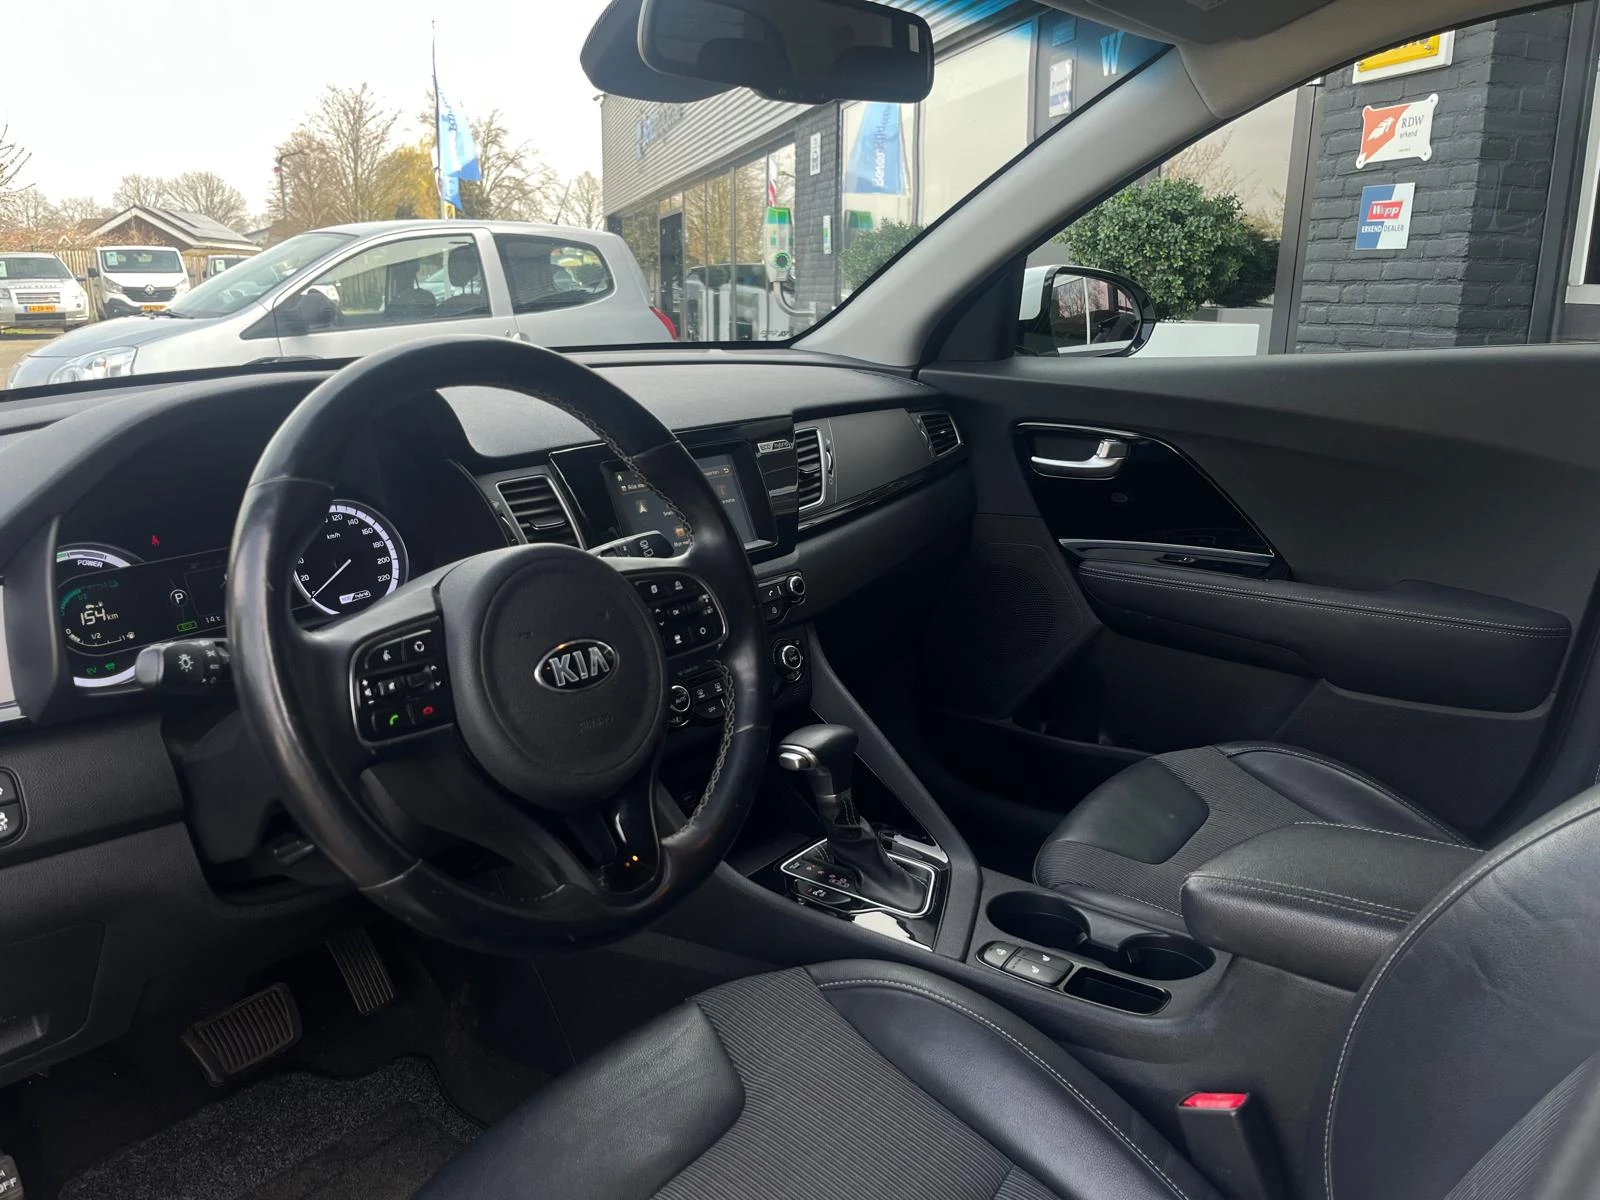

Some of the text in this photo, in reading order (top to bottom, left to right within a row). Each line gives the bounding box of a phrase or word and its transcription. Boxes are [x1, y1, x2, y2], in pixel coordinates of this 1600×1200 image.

[1401, 114, 1425, 128] RDW
[1400, 129, 1418, 139] erkend
[1361, 224, 1405, 233] ERKEND DEALER
[347, 518, 359, 526] 140
[361, 527, 374, 535] 160
[372, 541, 385, 549] 180
[77, 559, 104, 569] POWER
[377, 556, 391, 565] 200
[300, 574, 310, 582] 20
[377, 574, 391, 583] 220
[174, 592, 184, 604] P
[80, 608, 119, 626] 154 km
[90, 632, 102, 640] 1/2
[548, 646, 610, 687] KIA
